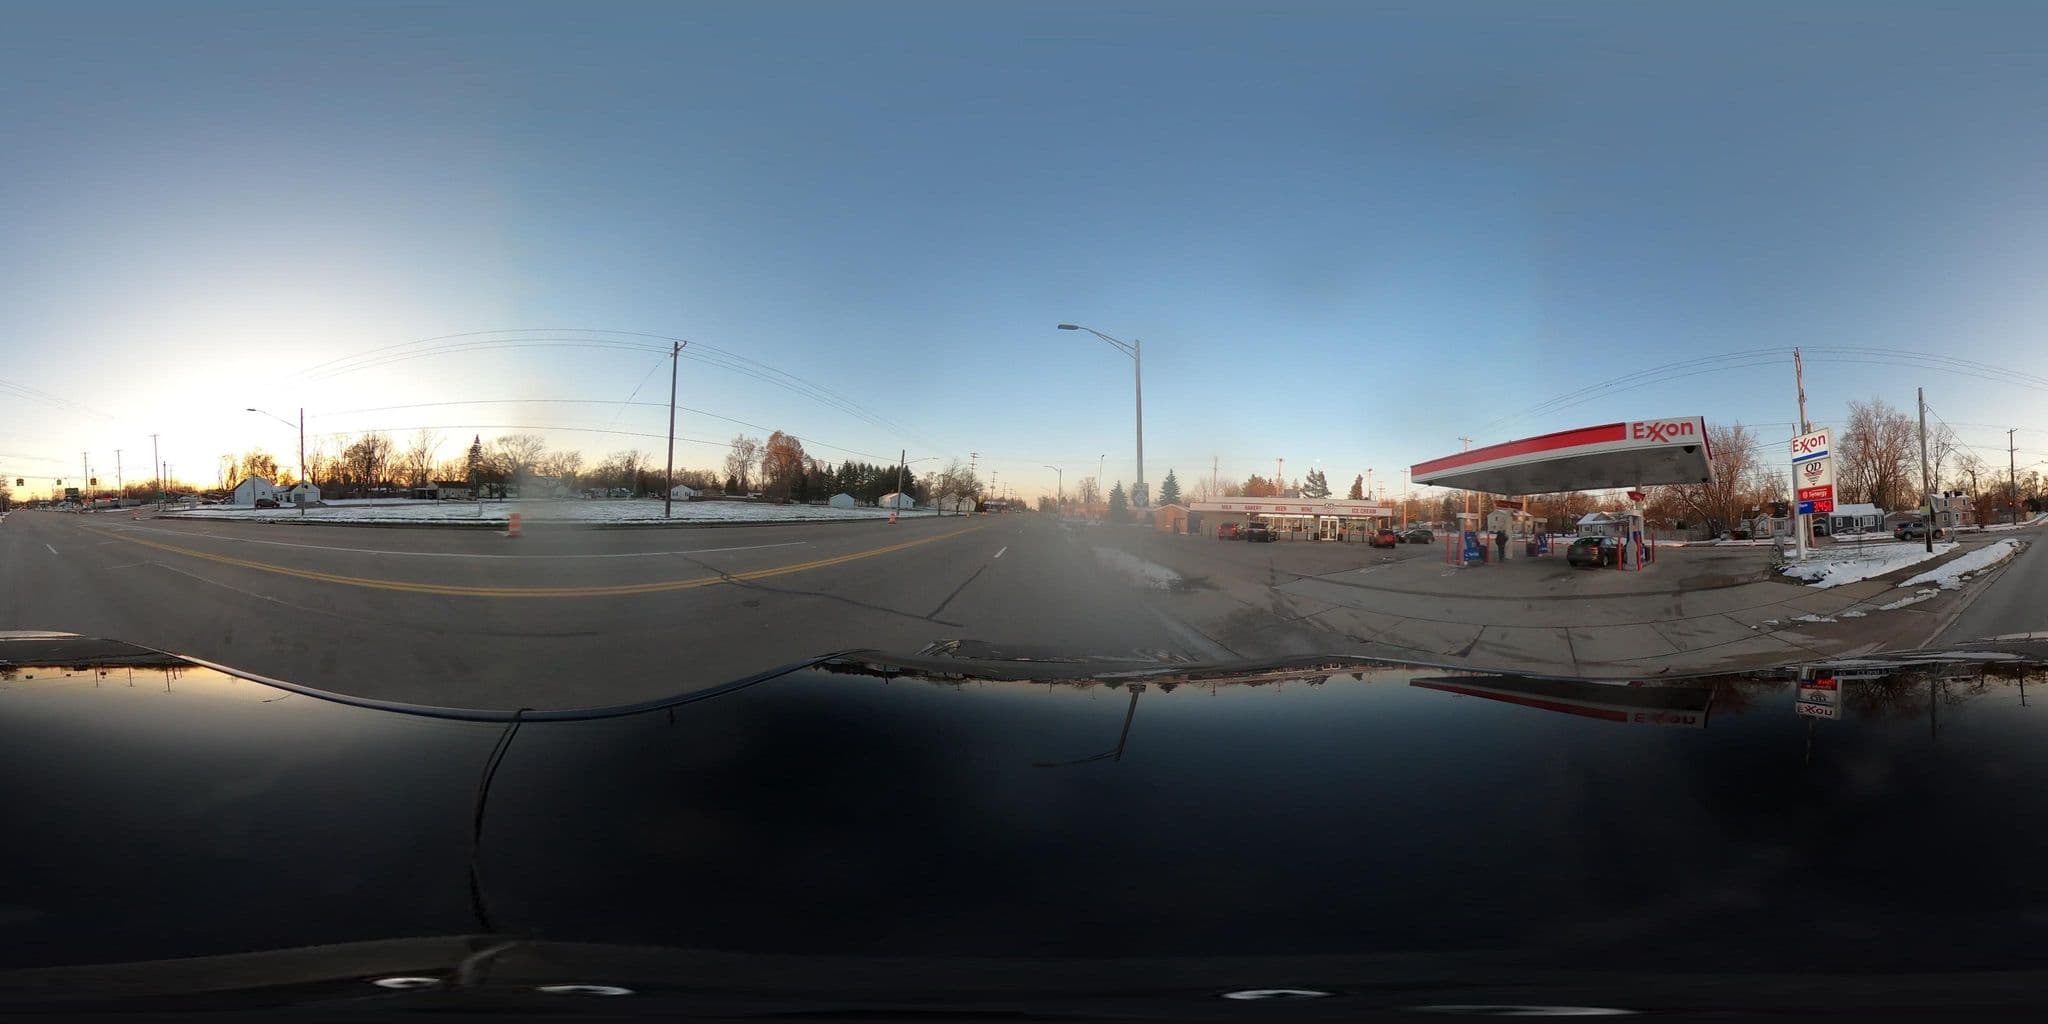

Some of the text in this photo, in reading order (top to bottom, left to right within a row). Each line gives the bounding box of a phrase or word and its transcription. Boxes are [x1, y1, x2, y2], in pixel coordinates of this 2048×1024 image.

[1632, 421, 1694, 443] Exxon
[1792, 434, 1826, 453] Exxon
[1805, 461, 1822, 475] QD
